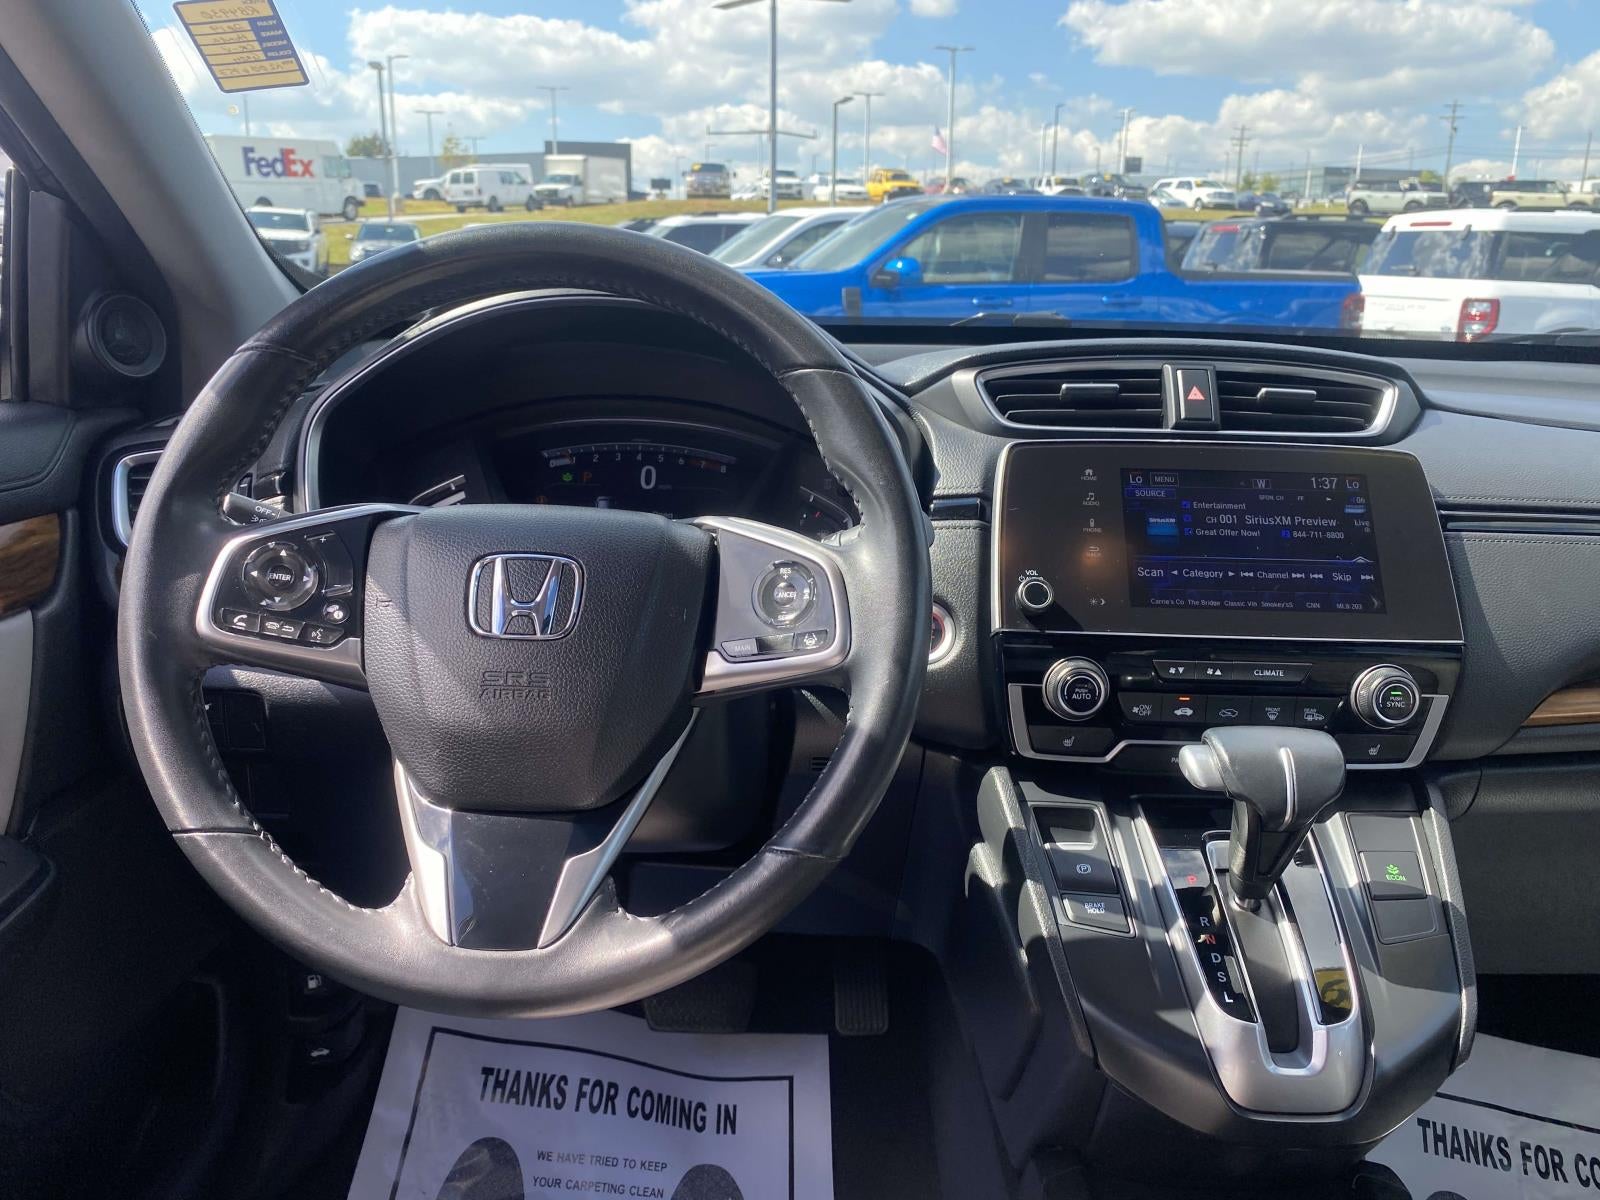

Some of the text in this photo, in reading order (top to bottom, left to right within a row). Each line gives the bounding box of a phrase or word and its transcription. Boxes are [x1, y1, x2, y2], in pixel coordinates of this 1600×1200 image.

[242, 146, 315, 178] FedEx
[593, 454, 600, 463] 2
[615, 453, 621, 461] 3
[636, 453, 642, 461] 4
[658, 454, 664, 463] 5
[678, 457, 685, 465] 6
[700, 461, 706, 469] 7
[720, 465, 727, 473] 8
[583, 471, 593, 482] P
[640, 465, 657, 490] 0
[1129, 474, 1143, 484] Lo
[1154, 475, 1175, 483] MENU
[1256, 479, 1266, 489] W
[1311, 477, 1338, 489] 1:37
[1346, 479, 1360, 489] Lo
[1135, 489, 1167, 497] SOURCE
[255, 505, 272, 514] OFF
[1193, 501, 1246, 510] Entertainment
[1205, 514, 1238, 524] CH 001
[1245, 515, 1337, 527] SiriusXM Preview
[1195, 528, 1260, 537] Great Offer Now!
[1293, 530, 1345, 539] 844-711-8800
[269, 572, 292, 581] ENTER
[1137, 566, 1164, 577] Scan
[1182, 568, 1224, 580] Category
[1257, 570, 1289, 580] Channel
[1332, 572, 1352, 582] Skip
[1201, 599, 1221, 607] Bridge
[482, 670, 552, 686] SRS
[1254, 669, 1284, 677] CLIMATE
[479, 687, 552, 700] AIRBAG
[1186, 874, 1197, 884] P
[1200, 916, 1210, 927] R
[1204, 934, 1216, 944] N
[1211, 952, 1221, 963] D
[1217, 971, 1227, 983] S
[1223, 991, 1234, 1003] L
[479, 1066, 738, 1135] THANKS FOR COMING IN
[1416, 1117, 1512, 1172] THANKS
[1519, 1141, 1569, 1184] FOR
[536, 1149, 668, 1173] WE HAVE TRIED TO KEEP
[532, 1175, 664, 1199] YOUR CARPETING CLEAN
